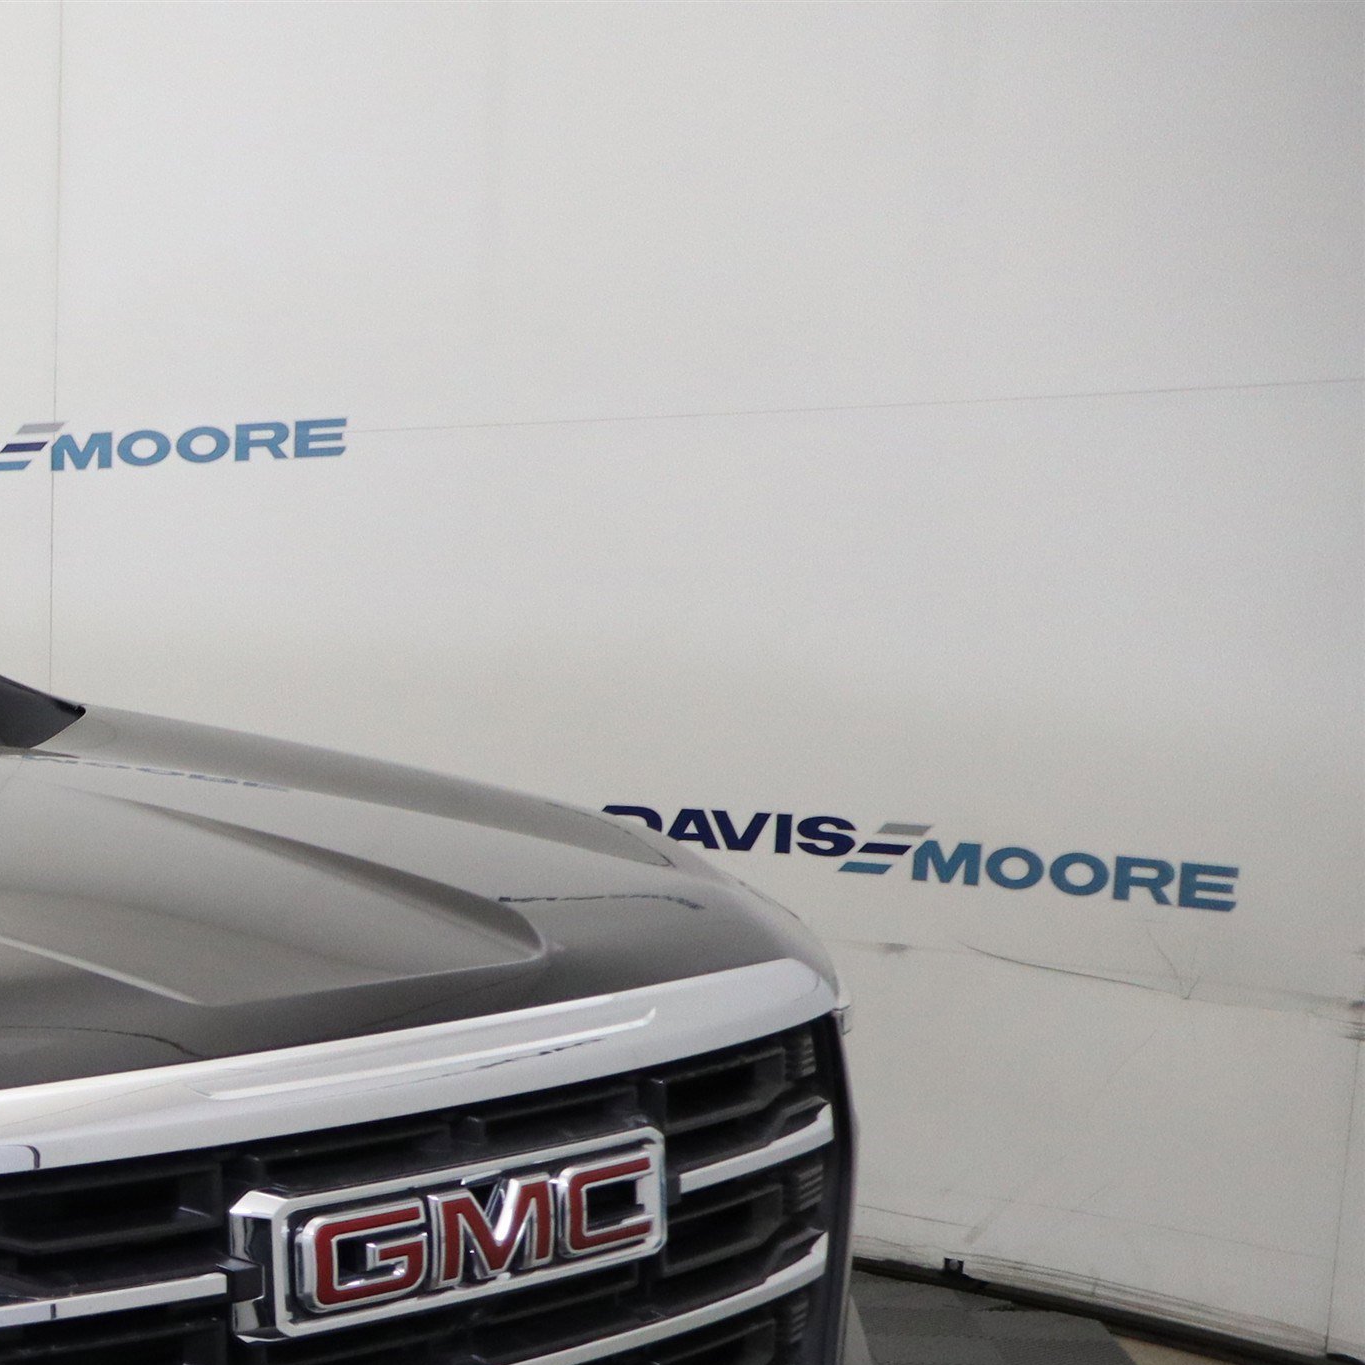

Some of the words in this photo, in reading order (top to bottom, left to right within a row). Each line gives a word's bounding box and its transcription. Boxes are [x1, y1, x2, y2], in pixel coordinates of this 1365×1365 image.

[50, 417, 348, 472] MOORE
[911, 839, 1239, 912] MOORE
[295, 1146, 655, 1313] GMC
